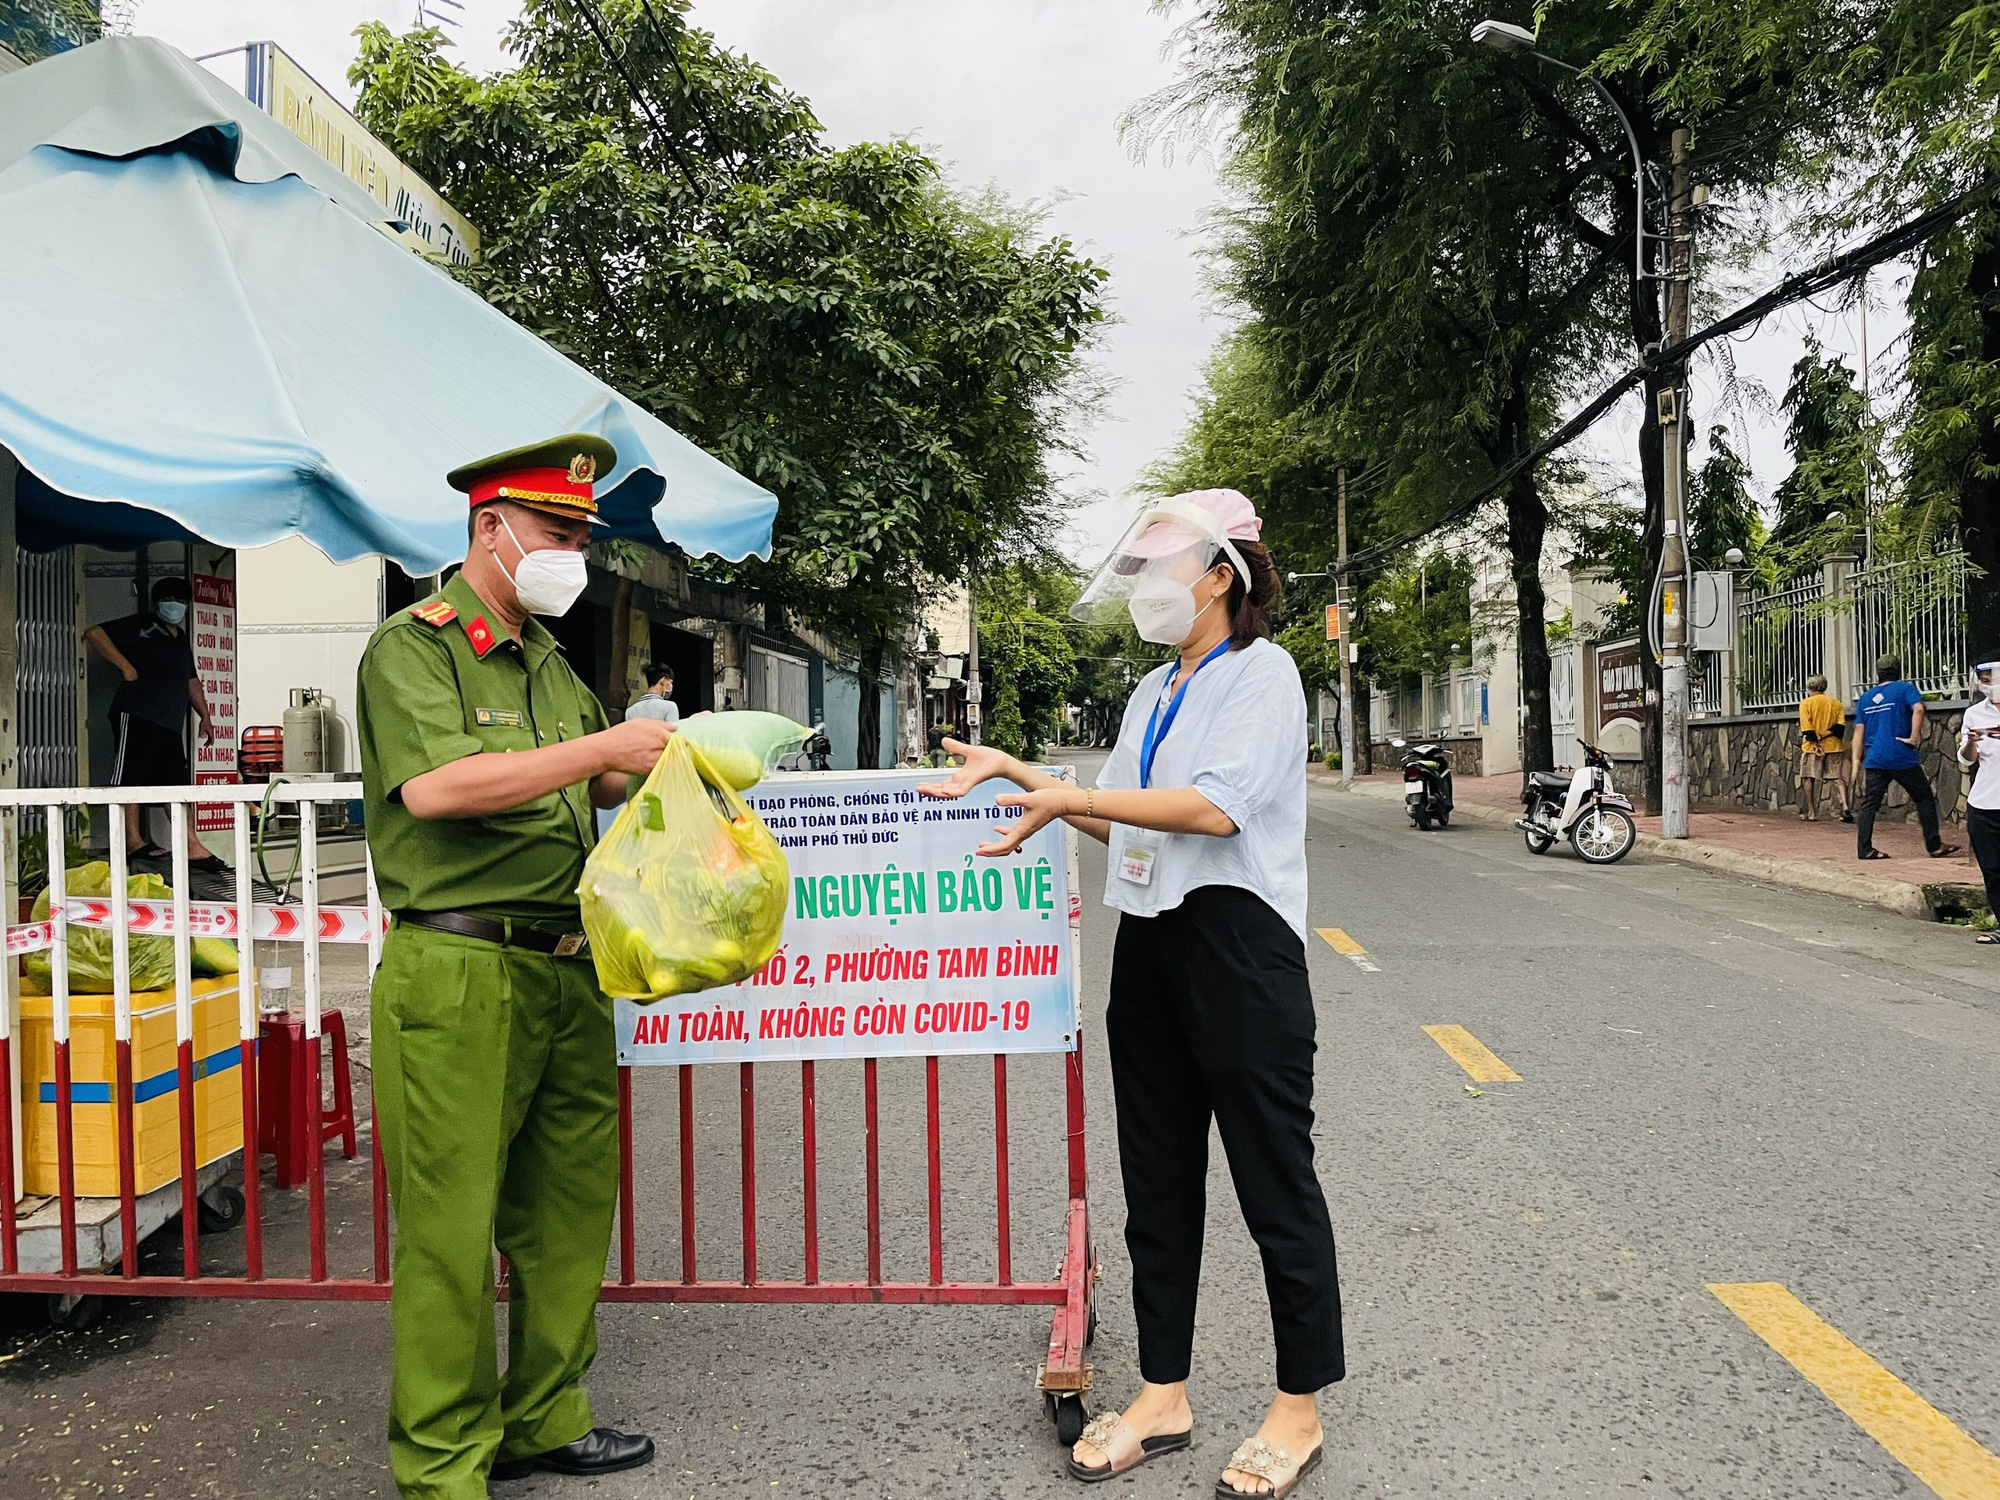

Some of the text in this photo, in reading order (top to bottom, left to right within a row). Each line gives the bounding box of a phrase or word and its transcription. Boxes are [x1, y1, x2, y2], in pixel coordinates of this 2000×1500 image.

[283, 86, 345, 172] BÁNH
[394, 186, 432, 245] Miền
[197, 610, 232, 628] TRANG TRÍ
[197, 632, 233, 651] CƯỚI HỎI
[197, 655, 233, 676] SINH NHẬT
[207, 680, 218, 694] GIA
[219, 678, 234, 695] TIÊN
[220, 699, 234, 718] QUẢ
[215, 747, 235, 765] NHẠC
[759, 798, 785, 812] ĐẠO
[790, 794, 840, 809] PHÒNG,
[843, 789, 889, 806] CHỐNG
[893, 789, 914, 805] TỘI
[763, 814, 797, 829] TRÀO
[801, 812, 836, 827] TOÀN
[841, 811, 867, 825] DÂN
[872, 808, 899, 824] BẢO
[903, 808, 919, 825] VỆ
[923, 810, 942, 821] AN
[947, 808, 980, 821] NINH
[1005, 806, 1022, 819] QU
[776, 829, 899, 848] ÀNH PHỐ THỦ ĐỨC
[795, 855, 1054, 925] NGUYỆN BẢO VỆ
[793, 955, 815, 987] 2,
[825, 943, 928, 984] PHƯỜNG
[937, 947, 989, 979] TAM
[996, 939, 1058, 977] BÌNH
[633, 997, 1030, 1044] AN TOÀN, KHÔNG CÒN COVID-19
